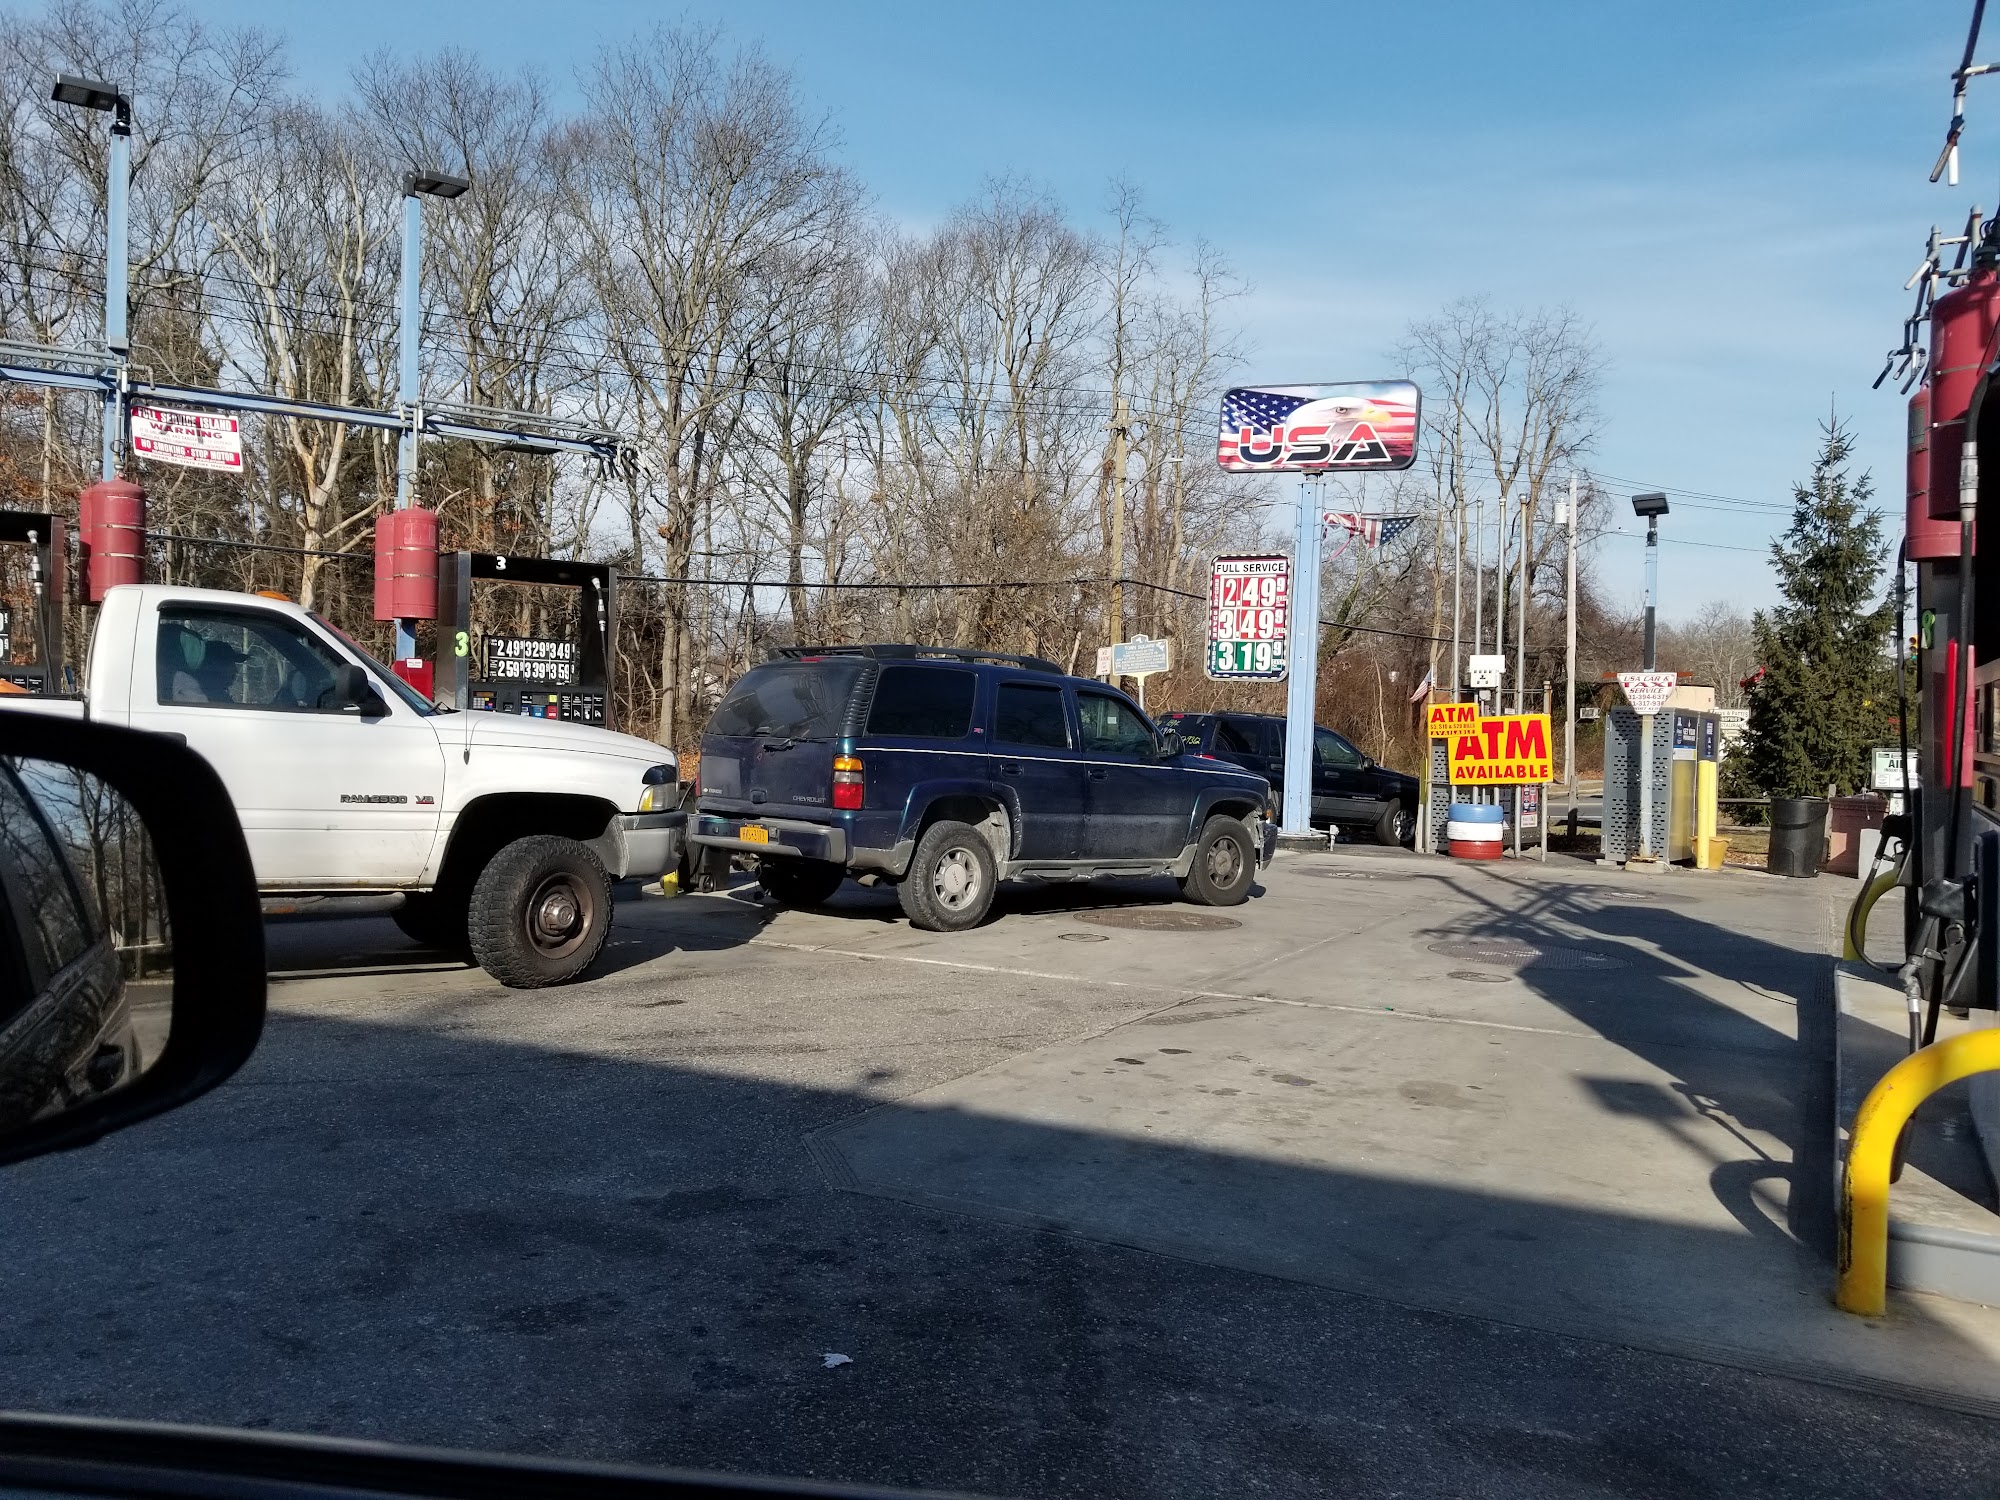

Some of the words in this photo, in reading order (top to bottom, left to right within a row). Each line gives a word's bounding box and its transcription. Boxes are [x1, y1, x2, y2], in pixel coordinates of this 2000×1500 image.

[138, 407, 157, 420] FULL
[160, 412, 196, 428] SERVICE
[200, 417, 232, 431] ISLAND
[149, 422, 223, 439] WARNING
[141, 438, 152, 449] NO
[153, 440, 185, 455] SMOKING
[191, 448, 208, 459] STOP
[210, 451, 235, 462] MOTOR
[1237, 421, 1393, 465] USA
[496, 556, 506, 570] 3
[1216, 564, 1240, 573] FULL
[1243, 562, 1285, 573] SERVICE
[455, 631, 469, 657] 3
[1431, 707, 1475, 723] ATM
[1455, 720, 1547, 761] ATM
[1455, 765, 1548, 779] AVAILABLE
[1889, 759, 1904, 769] AI
[340, 794, 369, 803] RAM
[370, 794, 408, 804] 2500
[415, 795, 434, 804] V8
[792, 795, 827, 804] CHEVROLET
